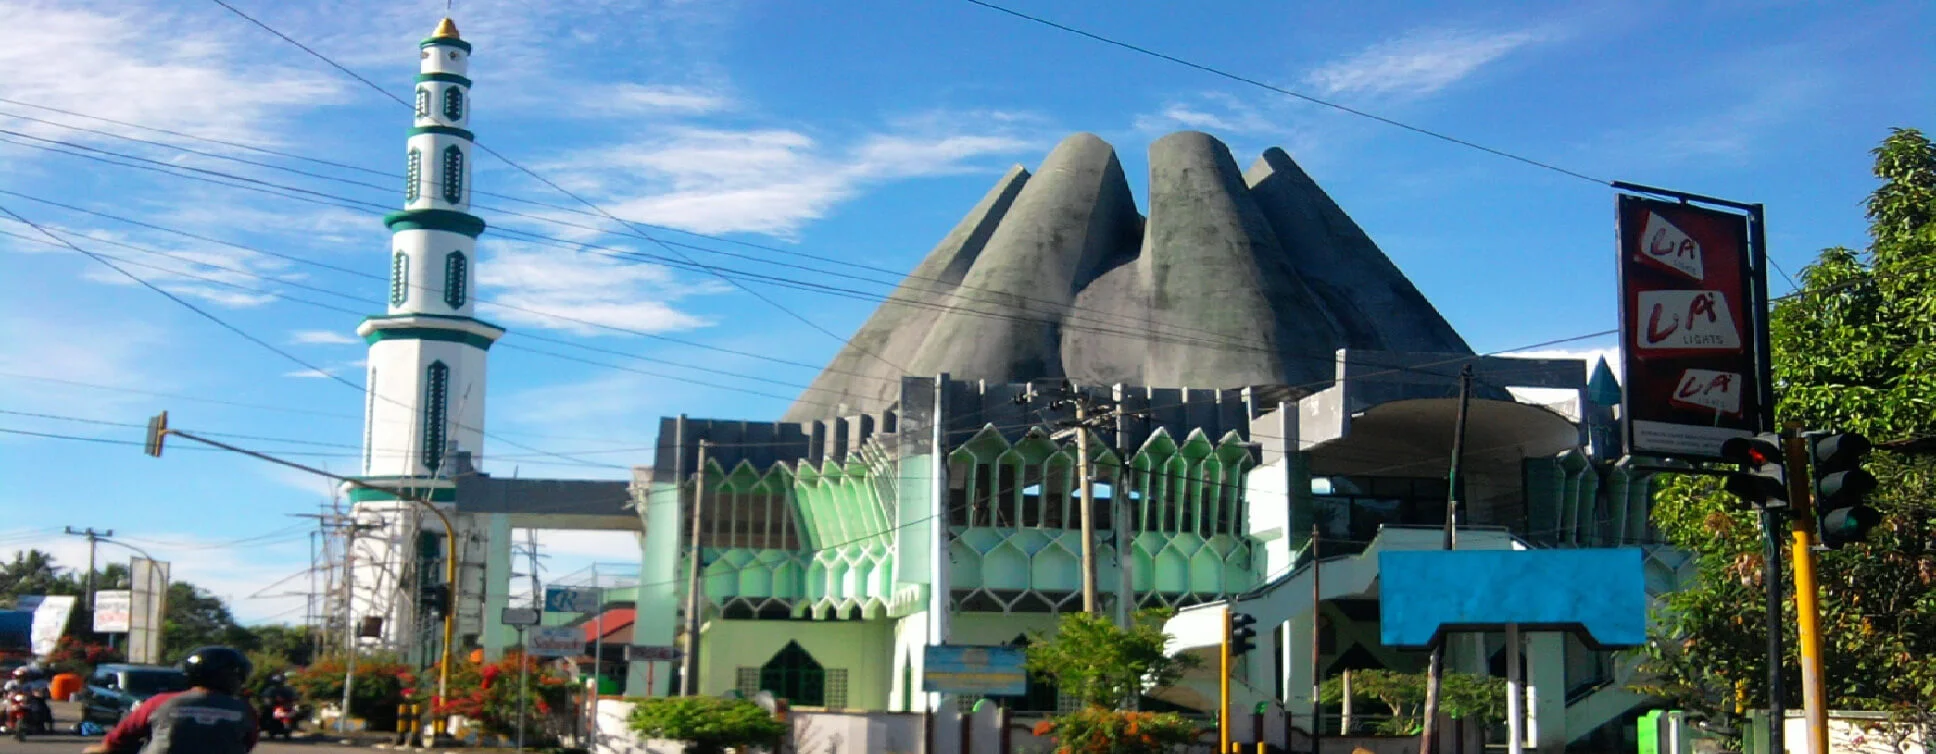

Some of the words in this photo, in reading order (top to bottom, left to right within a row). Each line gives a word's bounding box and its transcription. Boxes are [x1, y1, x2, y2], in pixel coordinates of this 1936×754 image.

[1651, 228, 1696, 260] LA
[1647, 293, 1716, 343] LA
[1683, 334, 1724, 345] LIGHTS
[1679, 375, 1729, 398] LA
